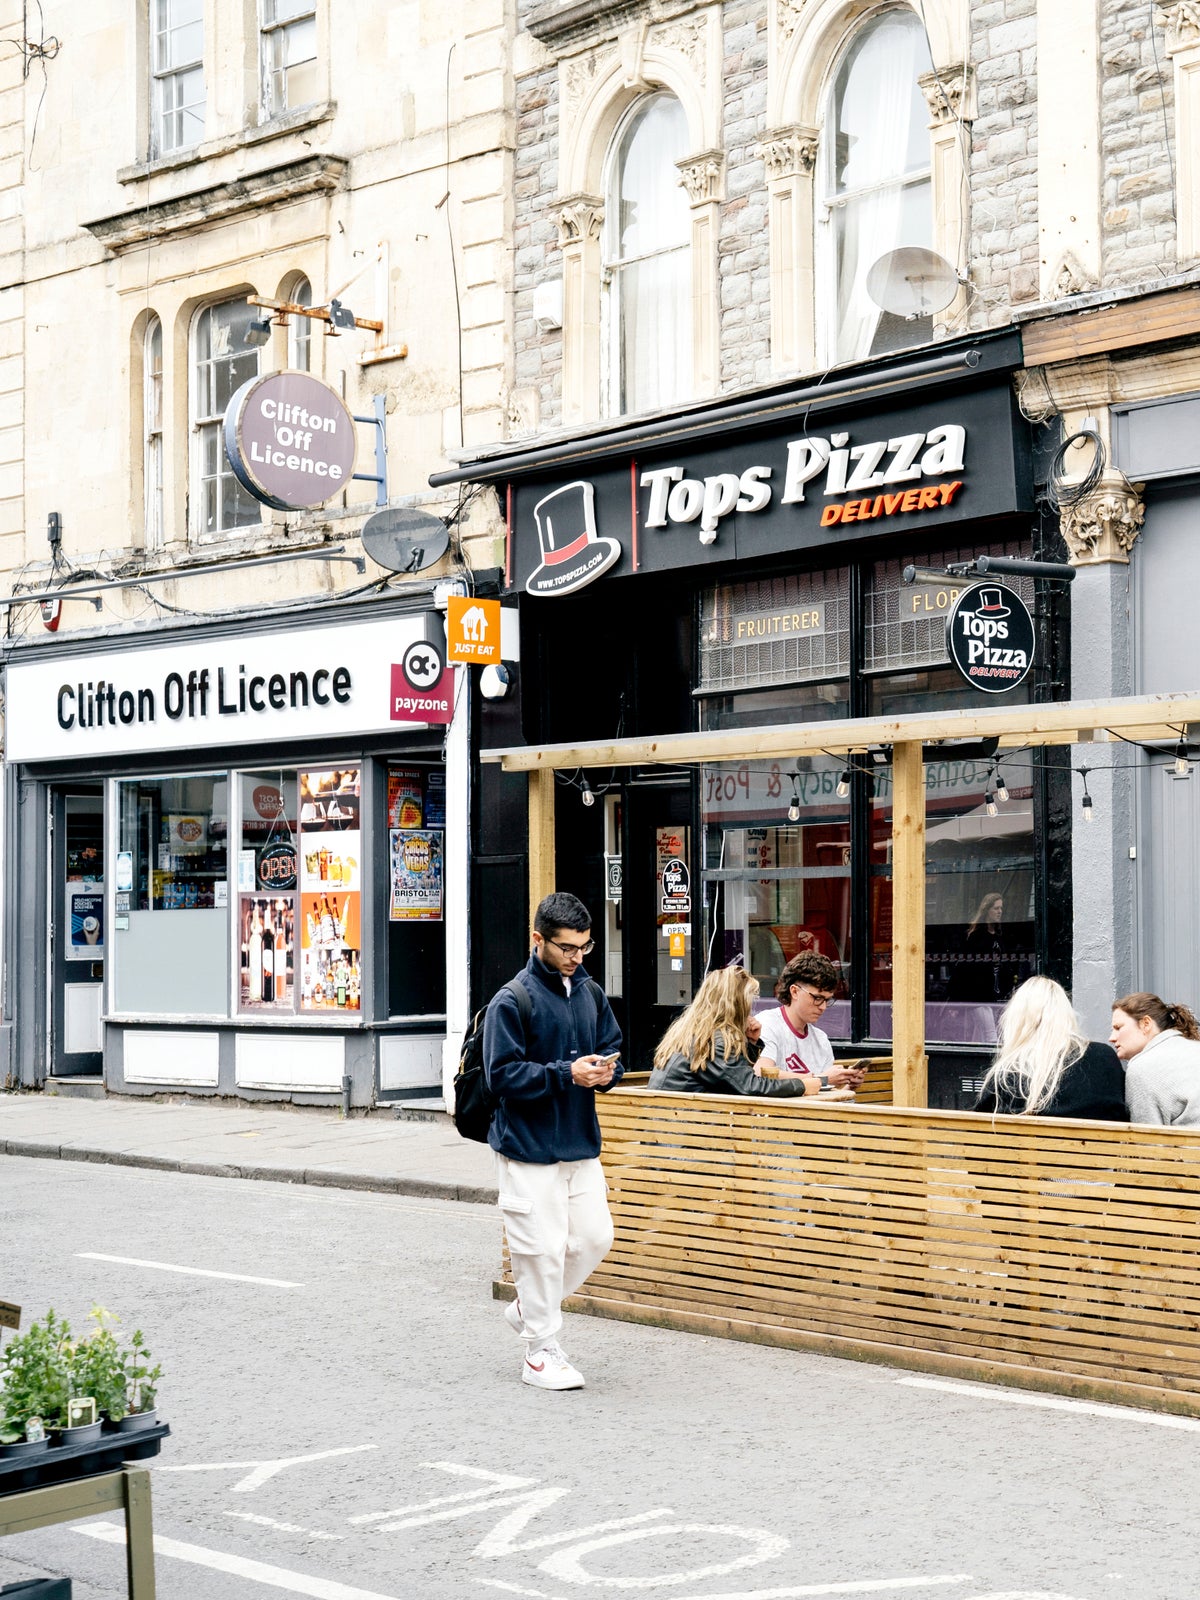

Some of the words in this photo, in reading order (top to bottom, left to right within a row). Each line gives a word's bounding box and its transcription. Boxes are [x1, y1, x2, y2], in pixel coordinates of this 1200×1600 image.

[261, 399, 336, 434] Clifton
[277, 427, 313, 451] Off
[250, 441, 343, 480] Licence
[639, 465, 772, 545] Tops
[781, 424, 967, 504] Pizza
[820, 481, 963, 527] DELIVERY
[537, 552, 603, 589] WWW.TOPSPIZZA.COM
[737, 610, 820, 638] FRUITERER
[958, 611, 1008, 645] Tops
[454, 643, 476, 654] JUST
[477, 645, 495, 655] EAT
[968, 639, 1027, 668] Pizza
[969, 666, 1022, 678] DELIVERY
[57, 680, 155, 730] Clifton
[164, 668, 209, 720] Off
[218, 664, 352, 715] Licence
[395, 697, 448, 713] payzone
[261, 855, 297, 881] OPEN
[405, 854, 429, 870] VEGAS
[664, 872, 681, 885] Tops
[668, 883, 687, 893] Pizza
[394, 889, 428, 897] BRISTOL
[667, 926, 687, 934] OPEN
[152, 1444, 791, 1589] ONLY
